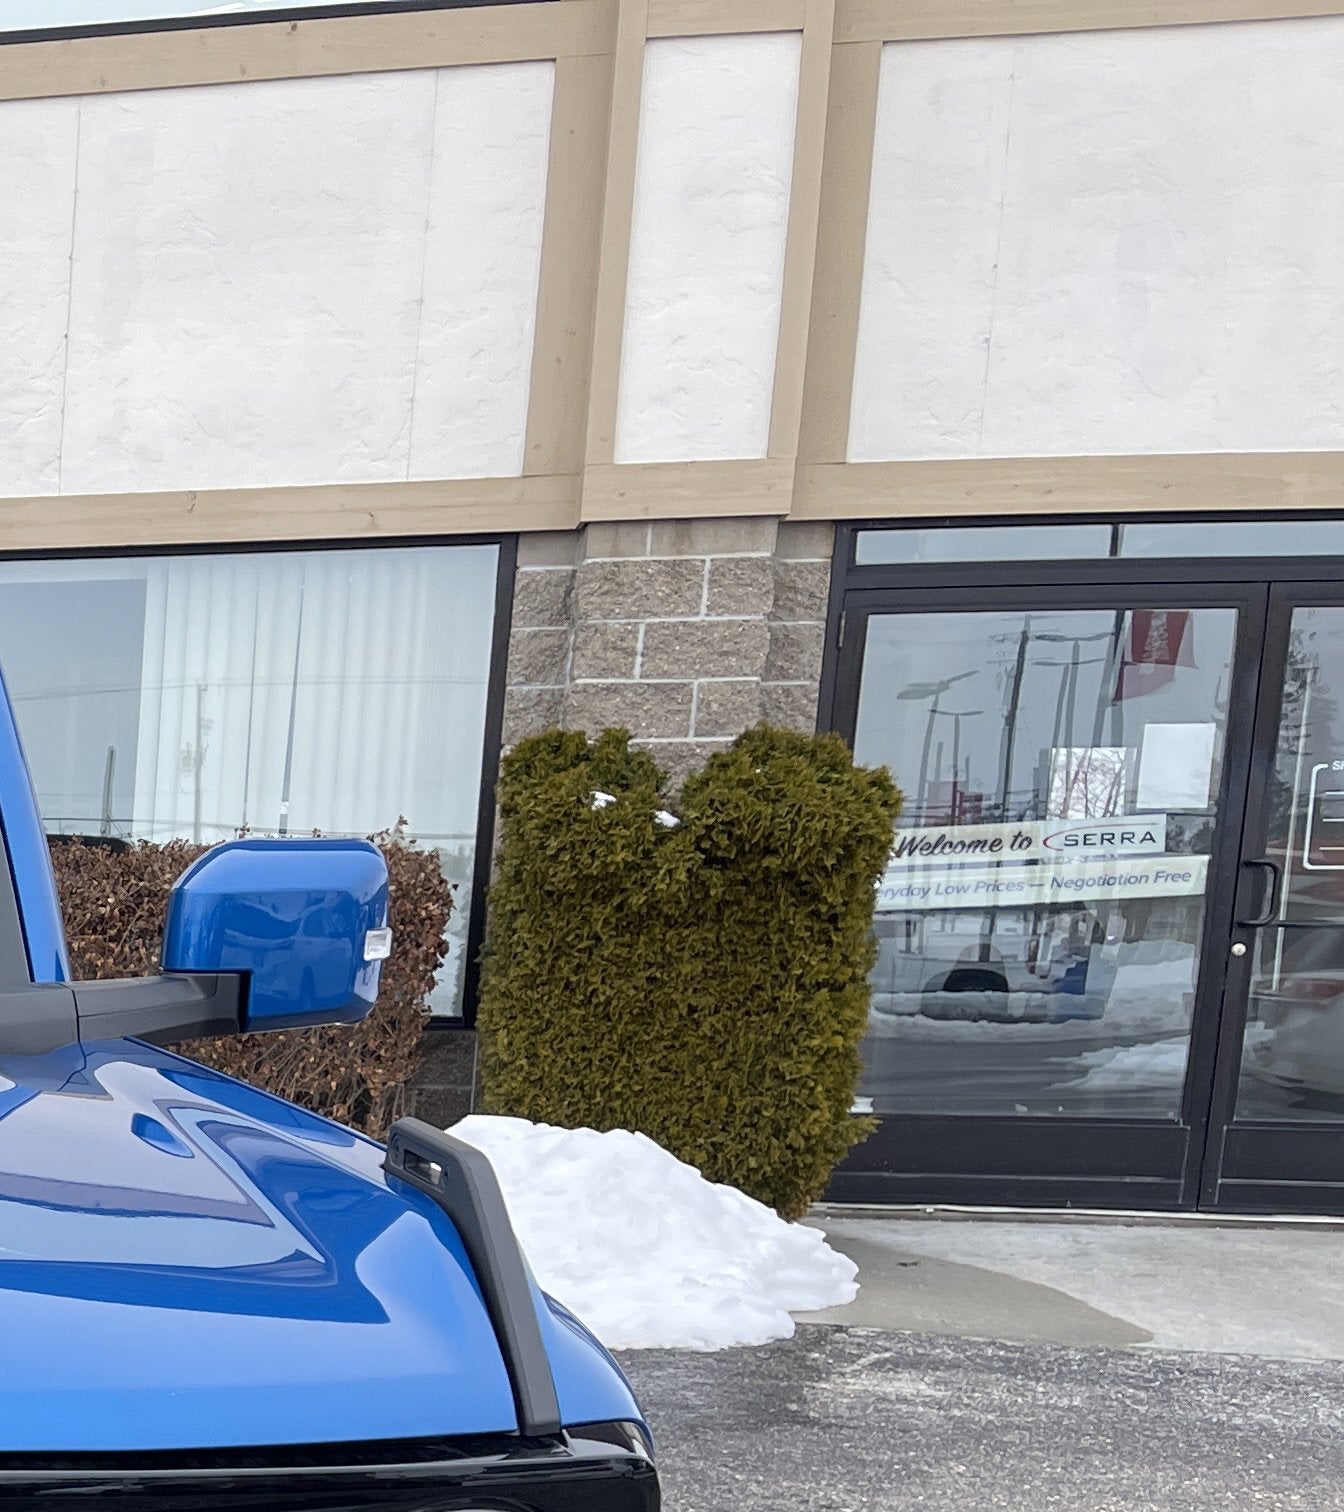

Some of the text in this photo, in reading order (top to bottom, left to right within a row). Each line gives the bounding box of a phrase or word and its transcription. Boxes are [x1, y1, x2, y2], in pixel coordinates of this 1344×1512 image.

[895, 830, 1157, 858] Welcome to SERRA
[879, 870, 1192, 900] eryday Low Prices Negotiation Free
